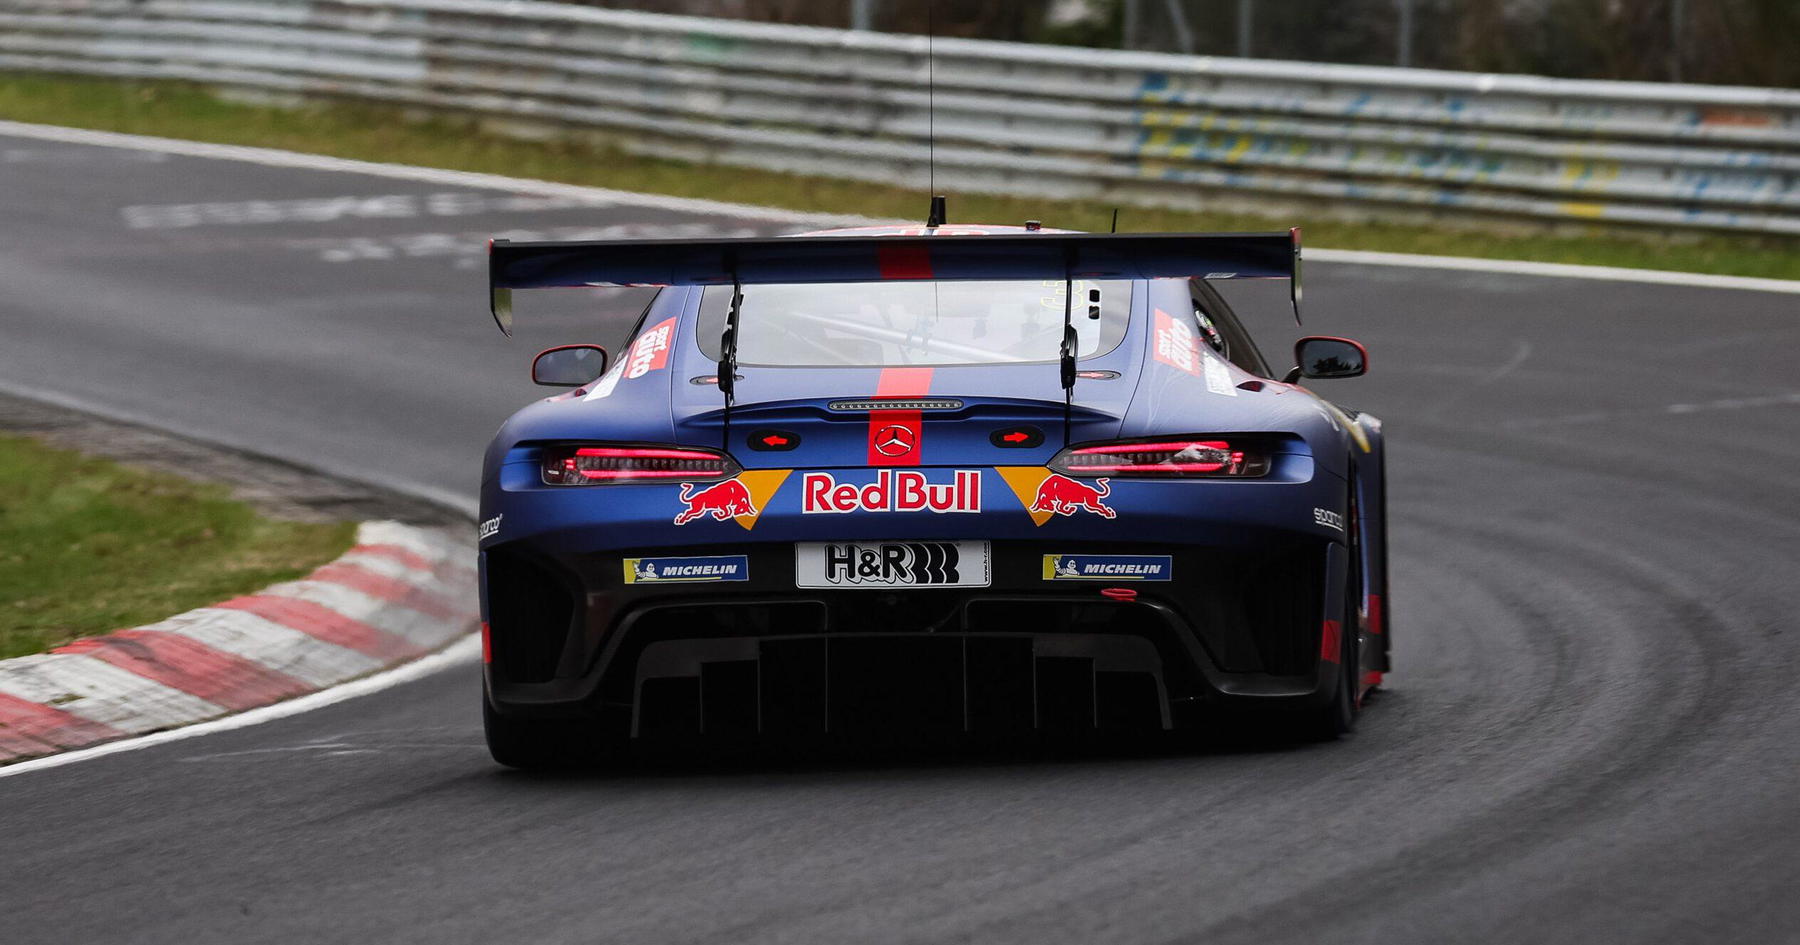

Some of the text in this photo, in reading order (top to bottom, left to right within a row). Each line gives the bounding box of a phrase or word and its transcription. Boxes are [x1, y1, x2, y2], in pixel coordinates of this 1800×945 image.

[628, 330, 656, 379] auto
[1169, 318, 1193, 371] auto
[802, 469, 981, 514] Red Bull
[662, 565, 738, 576] MICHELIN
[825, 543, 915, 584] H&R
[1084, 564, 1162, 574] MICHELIN
